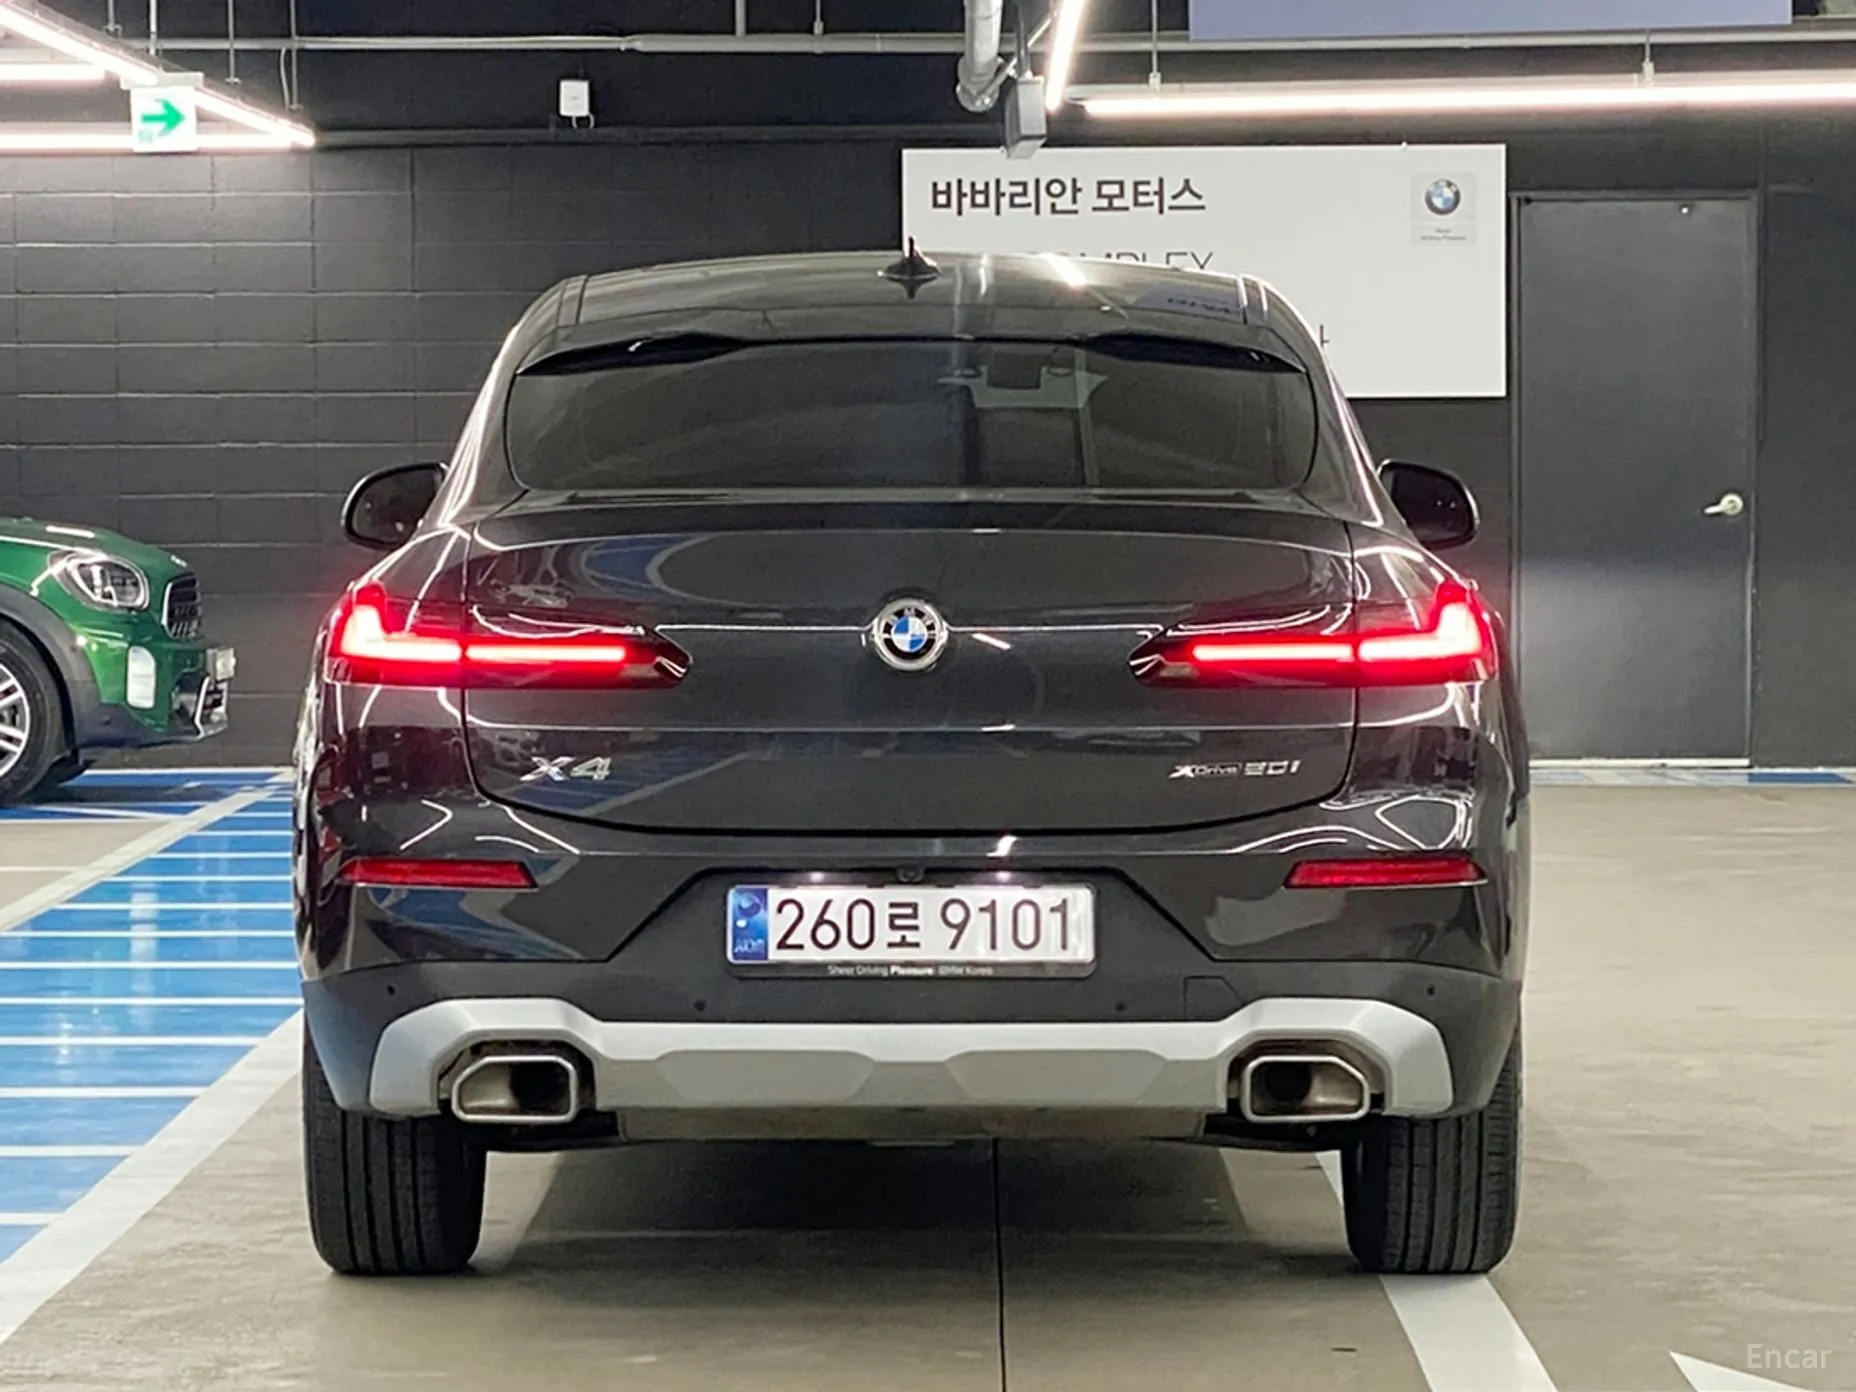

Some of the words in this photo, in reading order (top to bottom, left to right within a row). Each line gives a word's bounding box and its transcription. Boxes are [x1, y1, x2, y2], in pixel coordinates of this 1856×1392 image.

[931, 177, 1083, 217] 바바리안
[1091, 176, 1206, 215] 모터스
[519, 756, 612, 781] X4
[775, 897, 921, 951] 260로
[939, 897, 1068, 951] 9101
